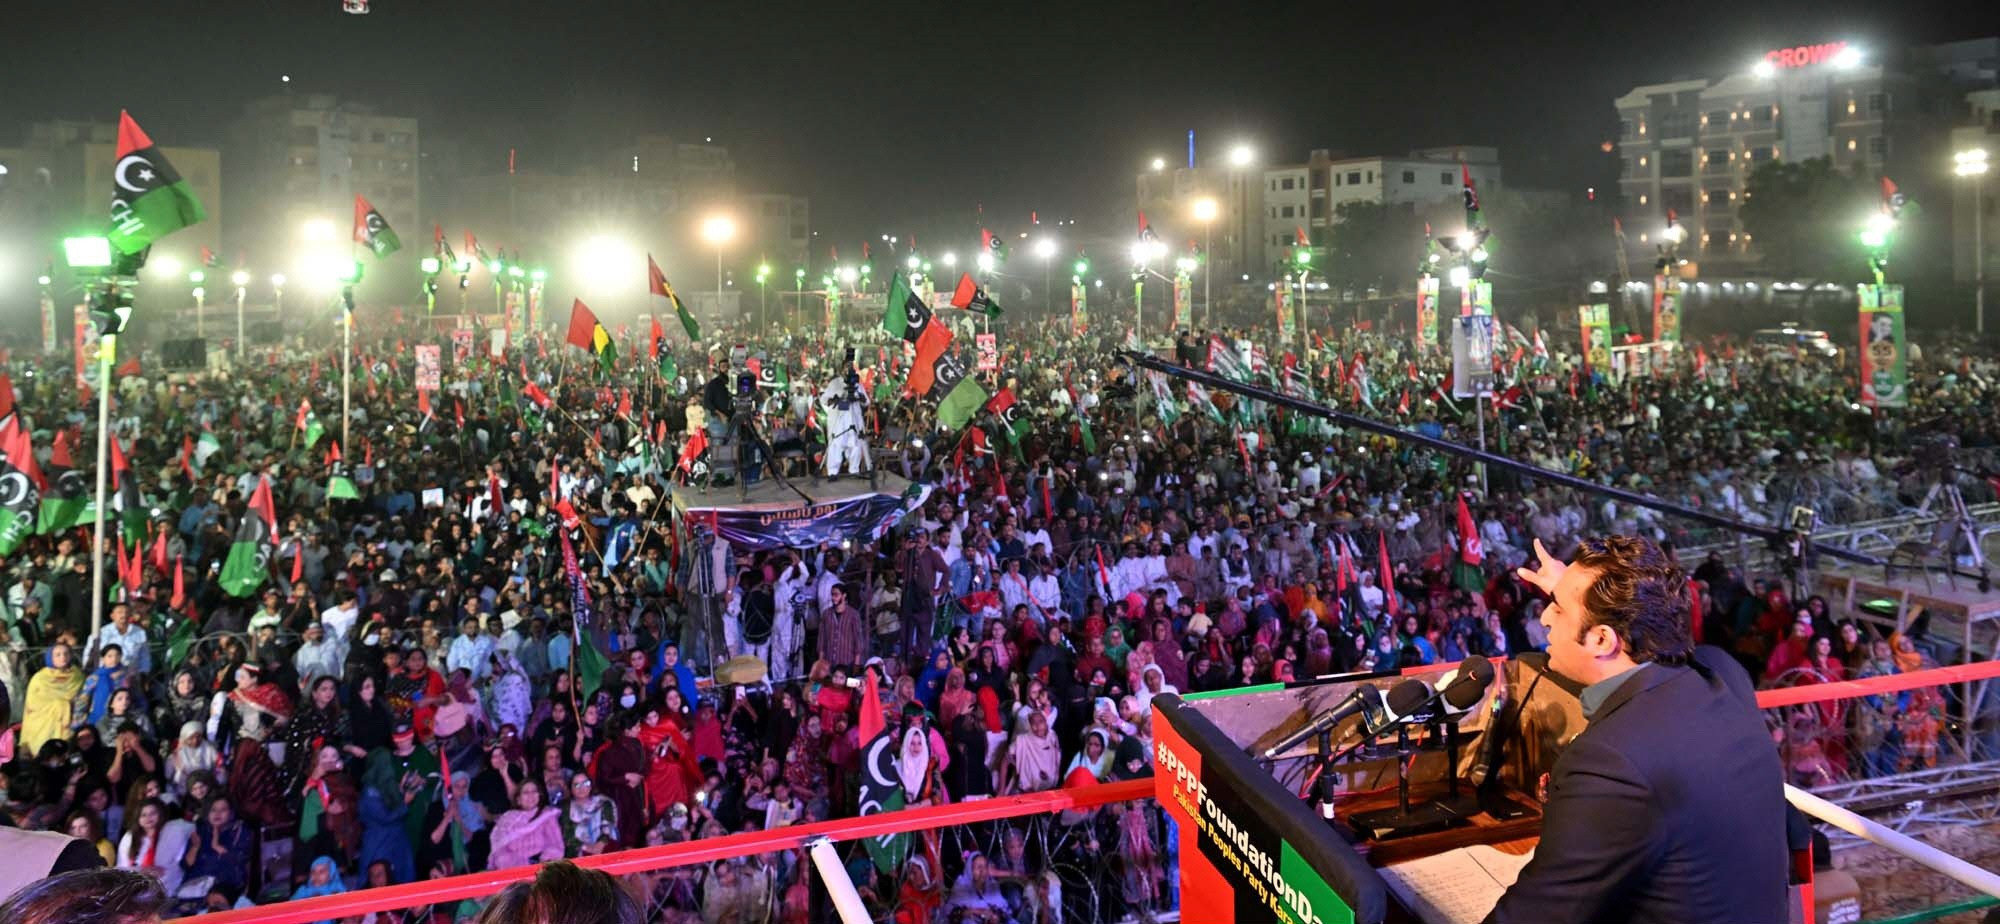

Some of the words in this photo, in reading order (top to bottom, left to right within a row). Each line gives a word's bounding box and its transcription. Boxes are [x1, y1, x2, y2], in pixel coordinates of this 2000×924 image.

[1173, 784, 1206, 832] Pakistan
[1208, 823, 1241, 872] Peoples
[1243, 864, 1268, 904] Party
